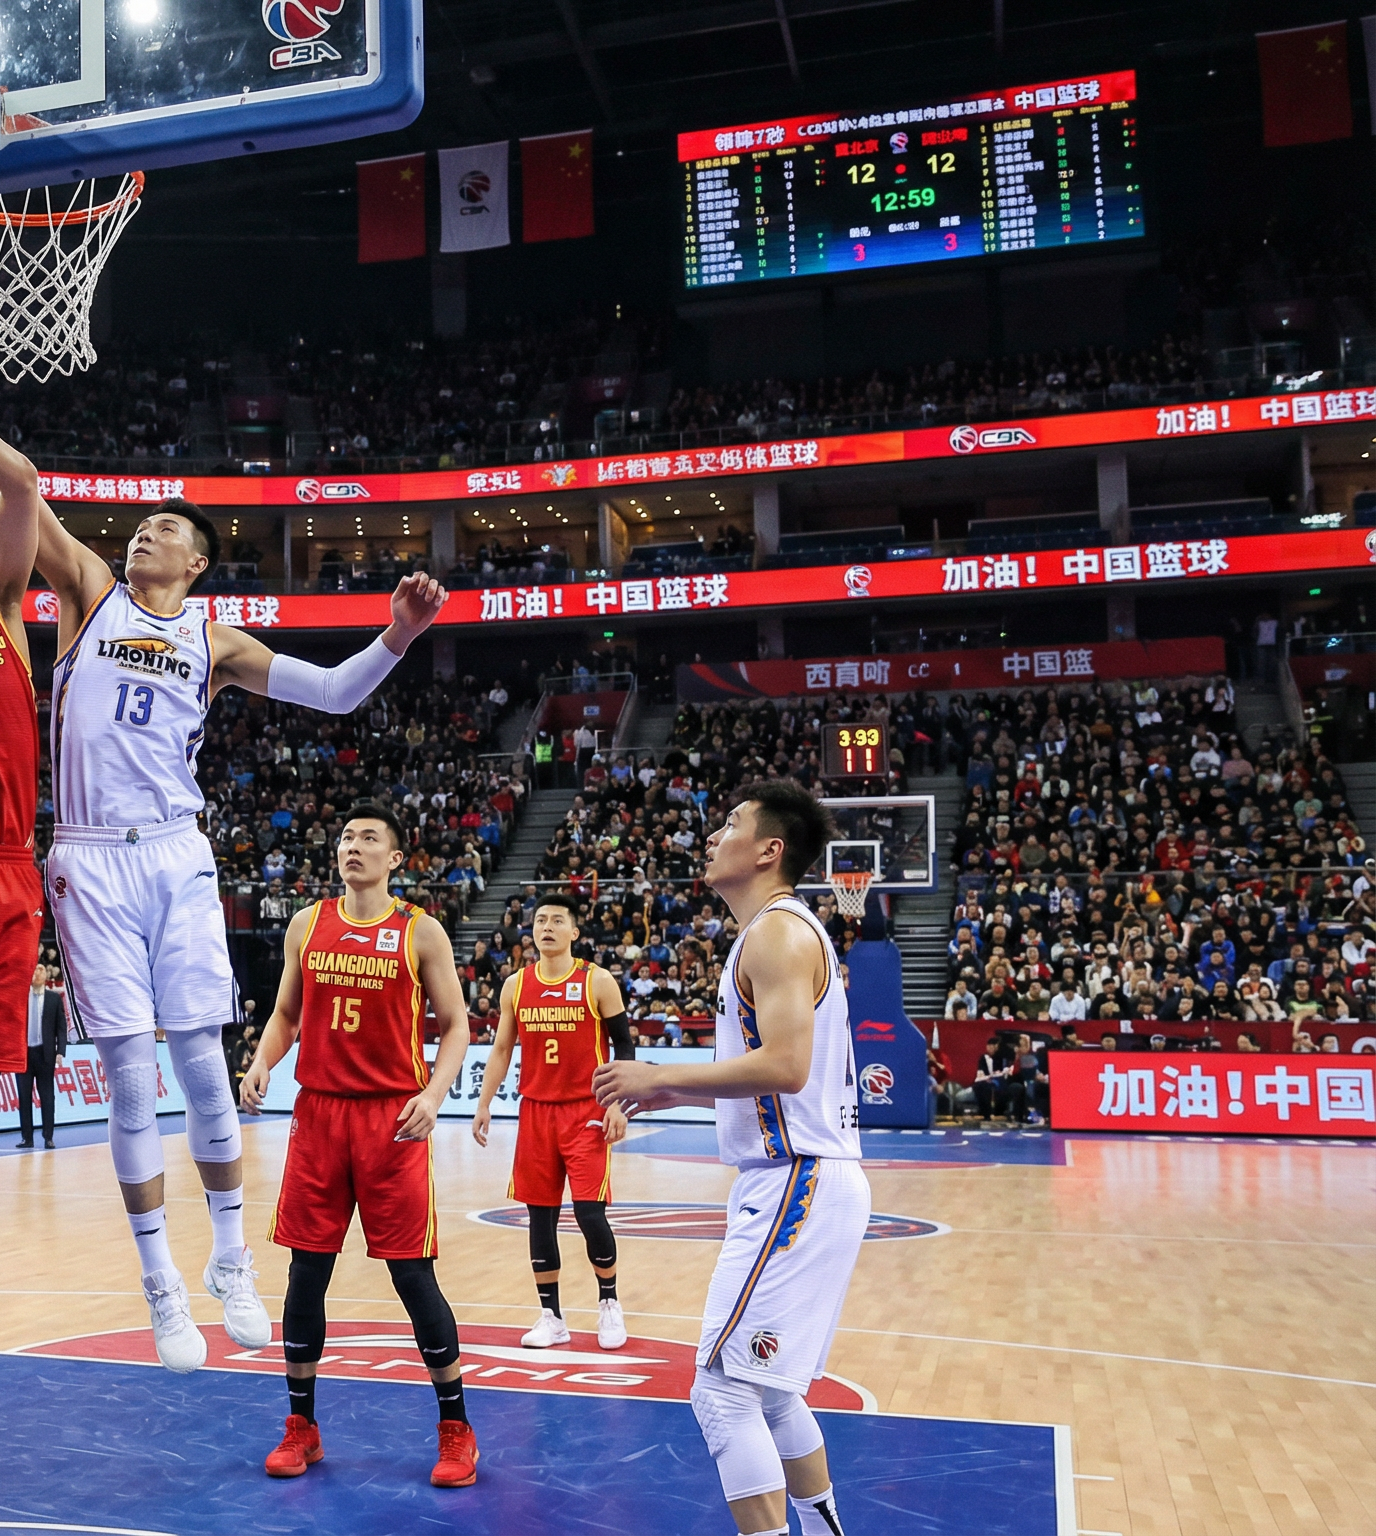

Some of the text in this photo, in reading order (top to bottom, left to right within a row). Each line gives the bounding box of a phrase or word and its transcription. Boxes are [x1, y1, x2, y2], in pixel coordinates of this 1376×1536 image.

[270, 41, 342, 70] CBA
[1015, 80, 1100, 109] 中国篮球
[847, 152, 956, 184] 12 12
[871, 188, 935, 212] 12:59
[944, 233, 958, 251] 3
[1156, 404, 1230, 435] 加油！
[941, 539, 1230, 591] 加油！ 中国篮球
[479, 573, 729, 621] 加油！ 中国篮球
[1003, 648, 1095, 679] 中国篮
[114, 683, 155, 726] 13
[307, 951, 399, 979] GUANGDONG
[330, 996, 362, 1033] 15
[545, 1038, 559, 1064] 2
